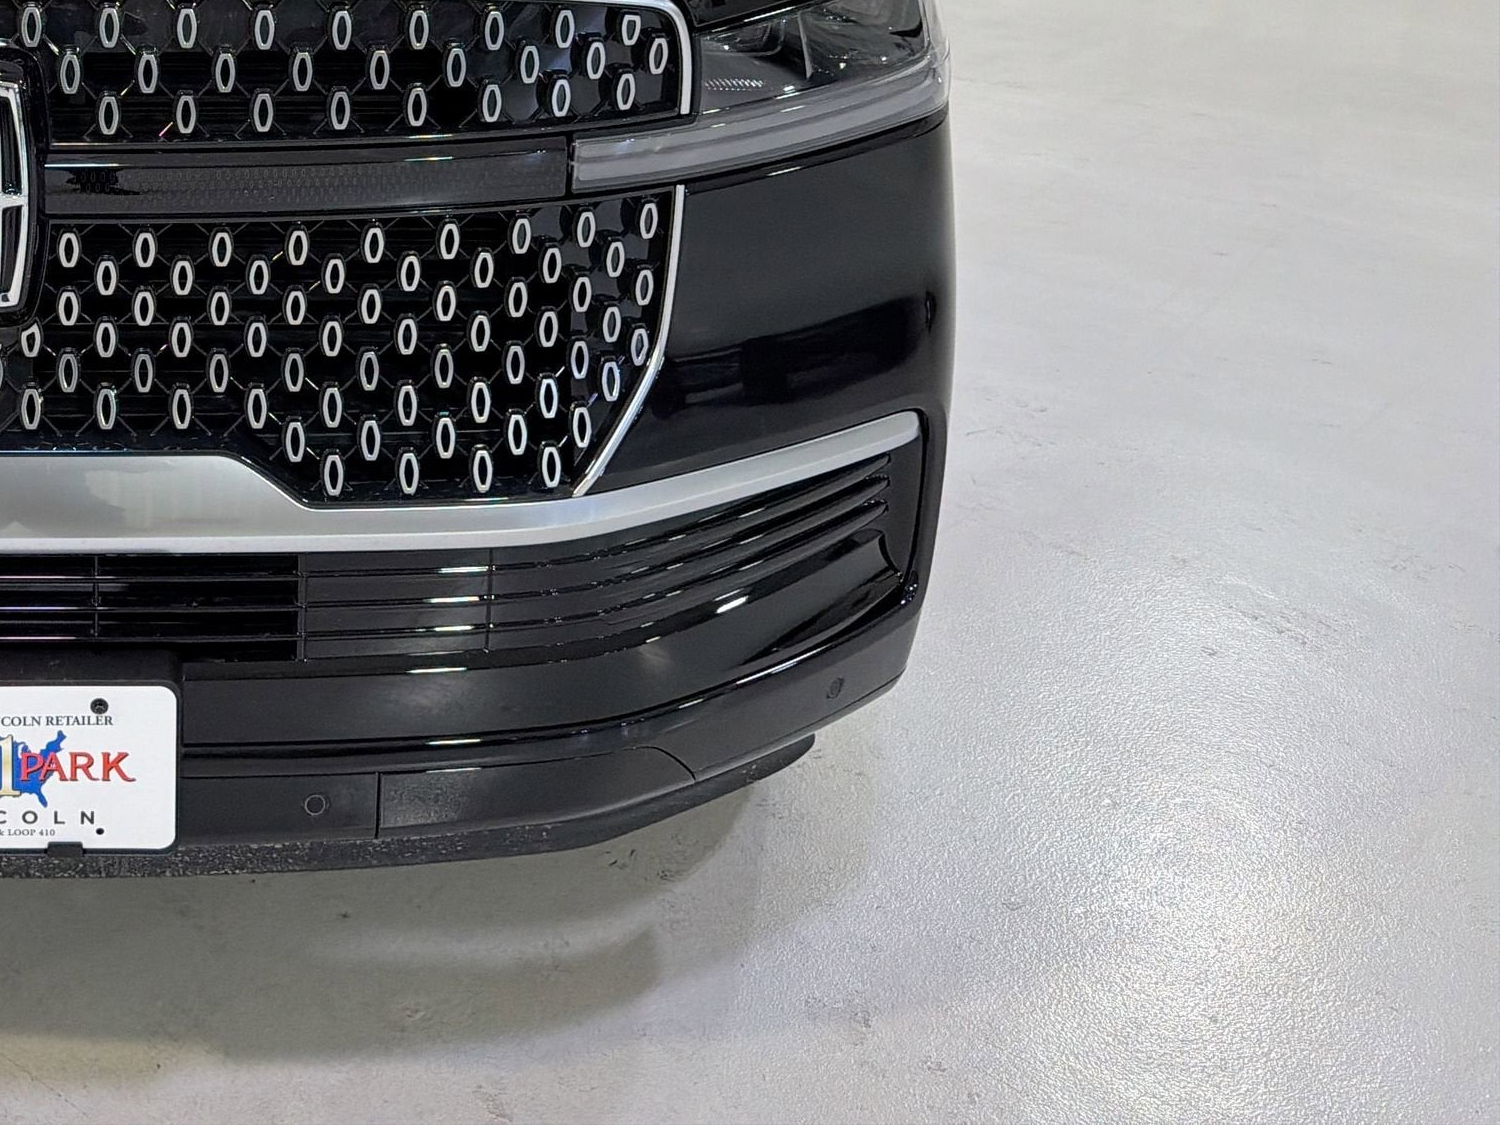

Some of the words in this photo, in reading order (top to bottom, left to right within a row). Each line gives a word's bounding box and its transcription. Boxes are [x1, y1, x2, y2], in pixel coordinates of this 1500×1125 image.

[45, 714, 114, 727] RETAILER
[19, 750, 137, 783] PARK
[7, 828, 37, 837] LOOP
[38, 827, 56, 837] 410
